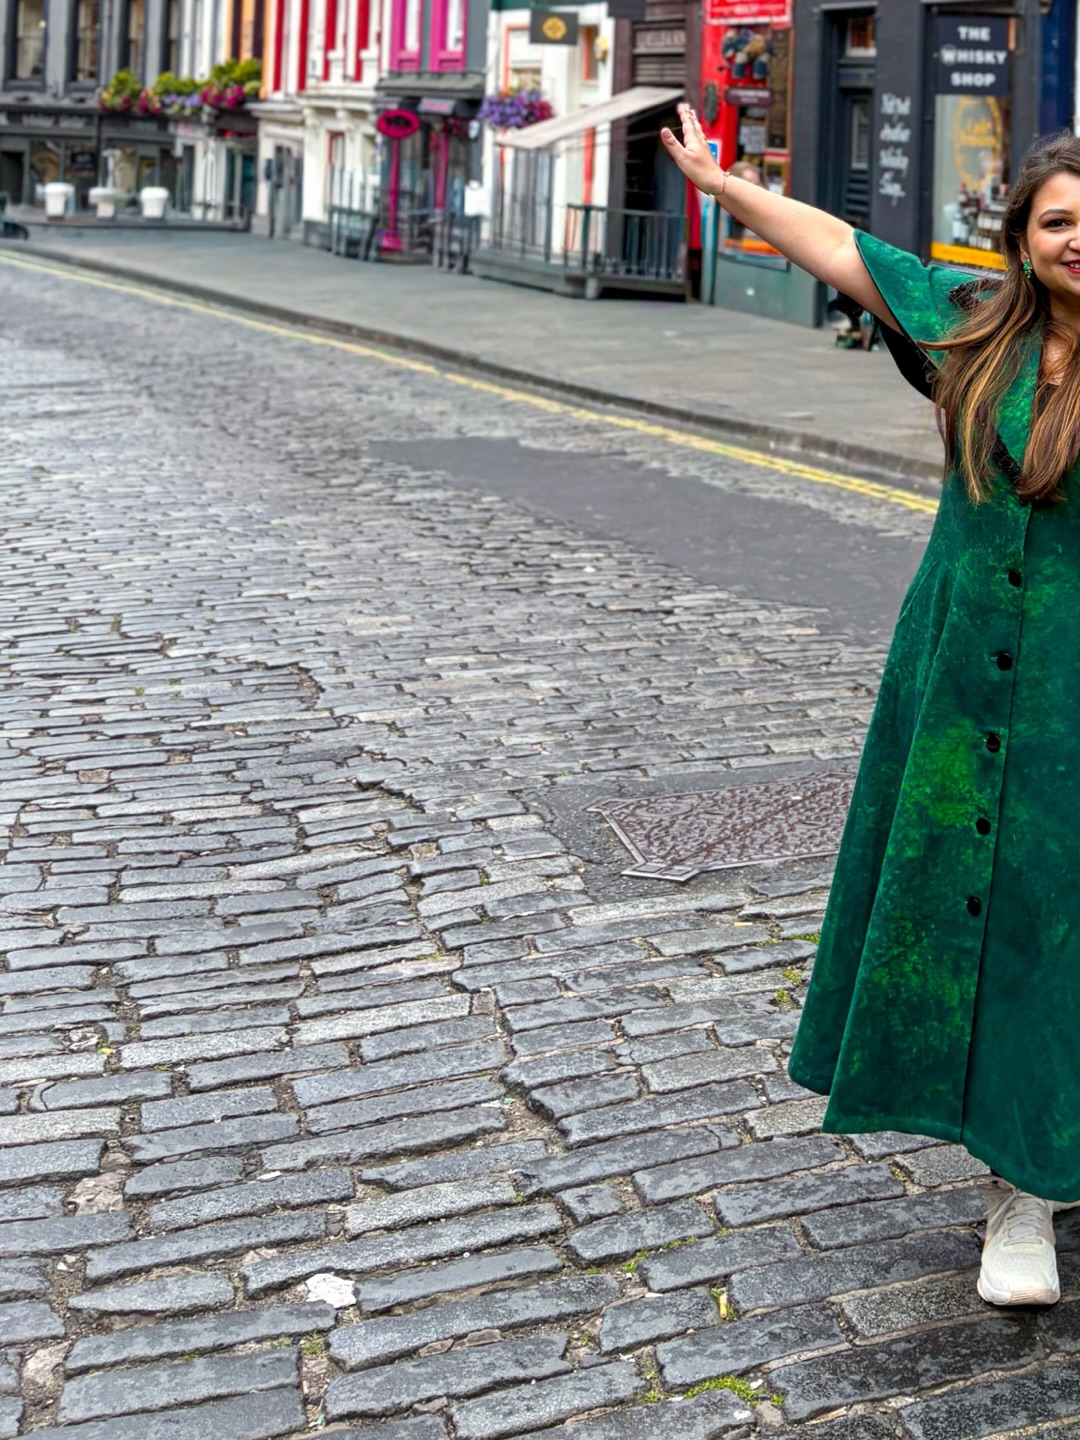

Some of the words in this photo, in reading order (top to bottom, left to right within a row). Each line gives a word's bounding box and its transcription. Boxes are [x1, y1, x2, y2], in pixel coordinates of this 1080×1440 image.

[957, 26, 991, 41] THE
[941, 48, 1008, 65] WHISKY
[950, 71, 996, 87] SHOP
